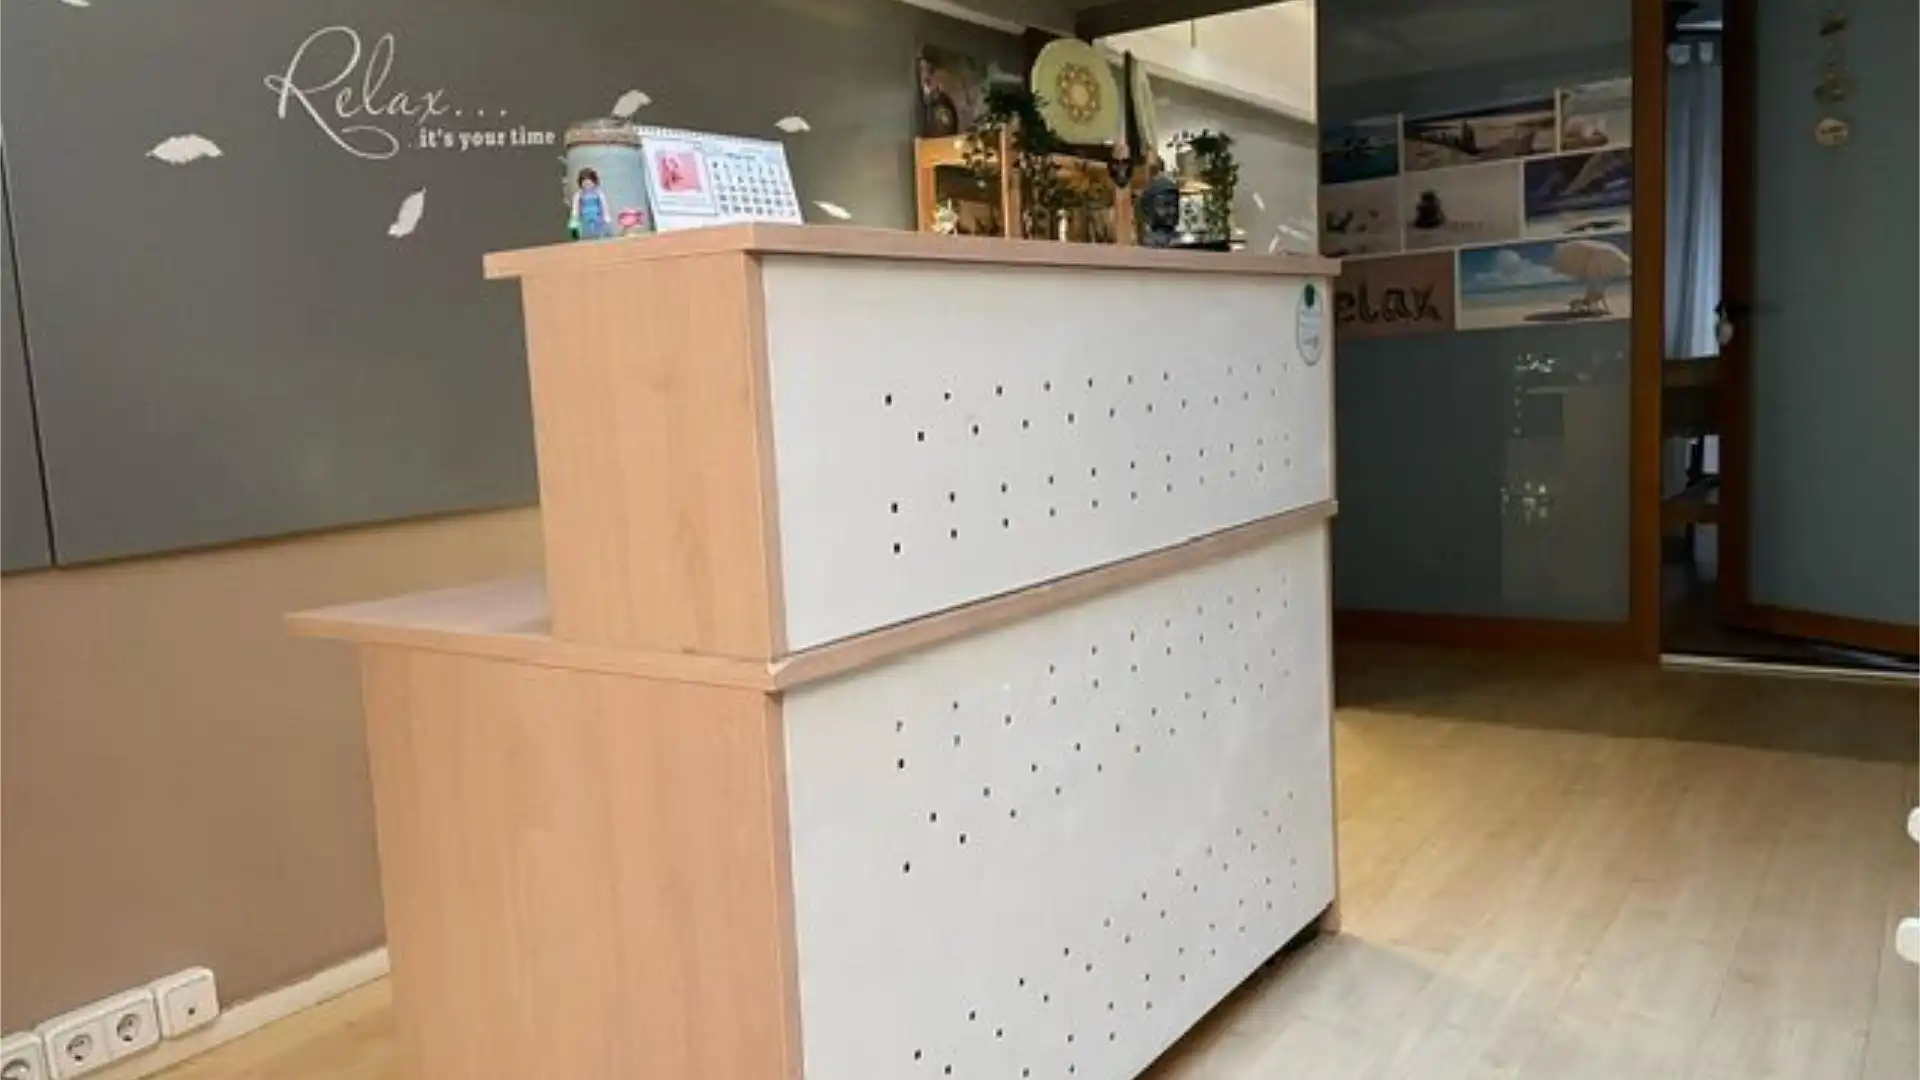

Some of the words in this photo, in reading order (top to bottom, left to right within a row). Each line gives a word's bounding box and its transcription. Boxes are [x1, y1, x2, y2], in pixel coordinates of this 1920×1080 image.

[458, 129, 506, 151] your
[509, 125, 556, 146] time
[1334, 281, 1442, 324] elax
